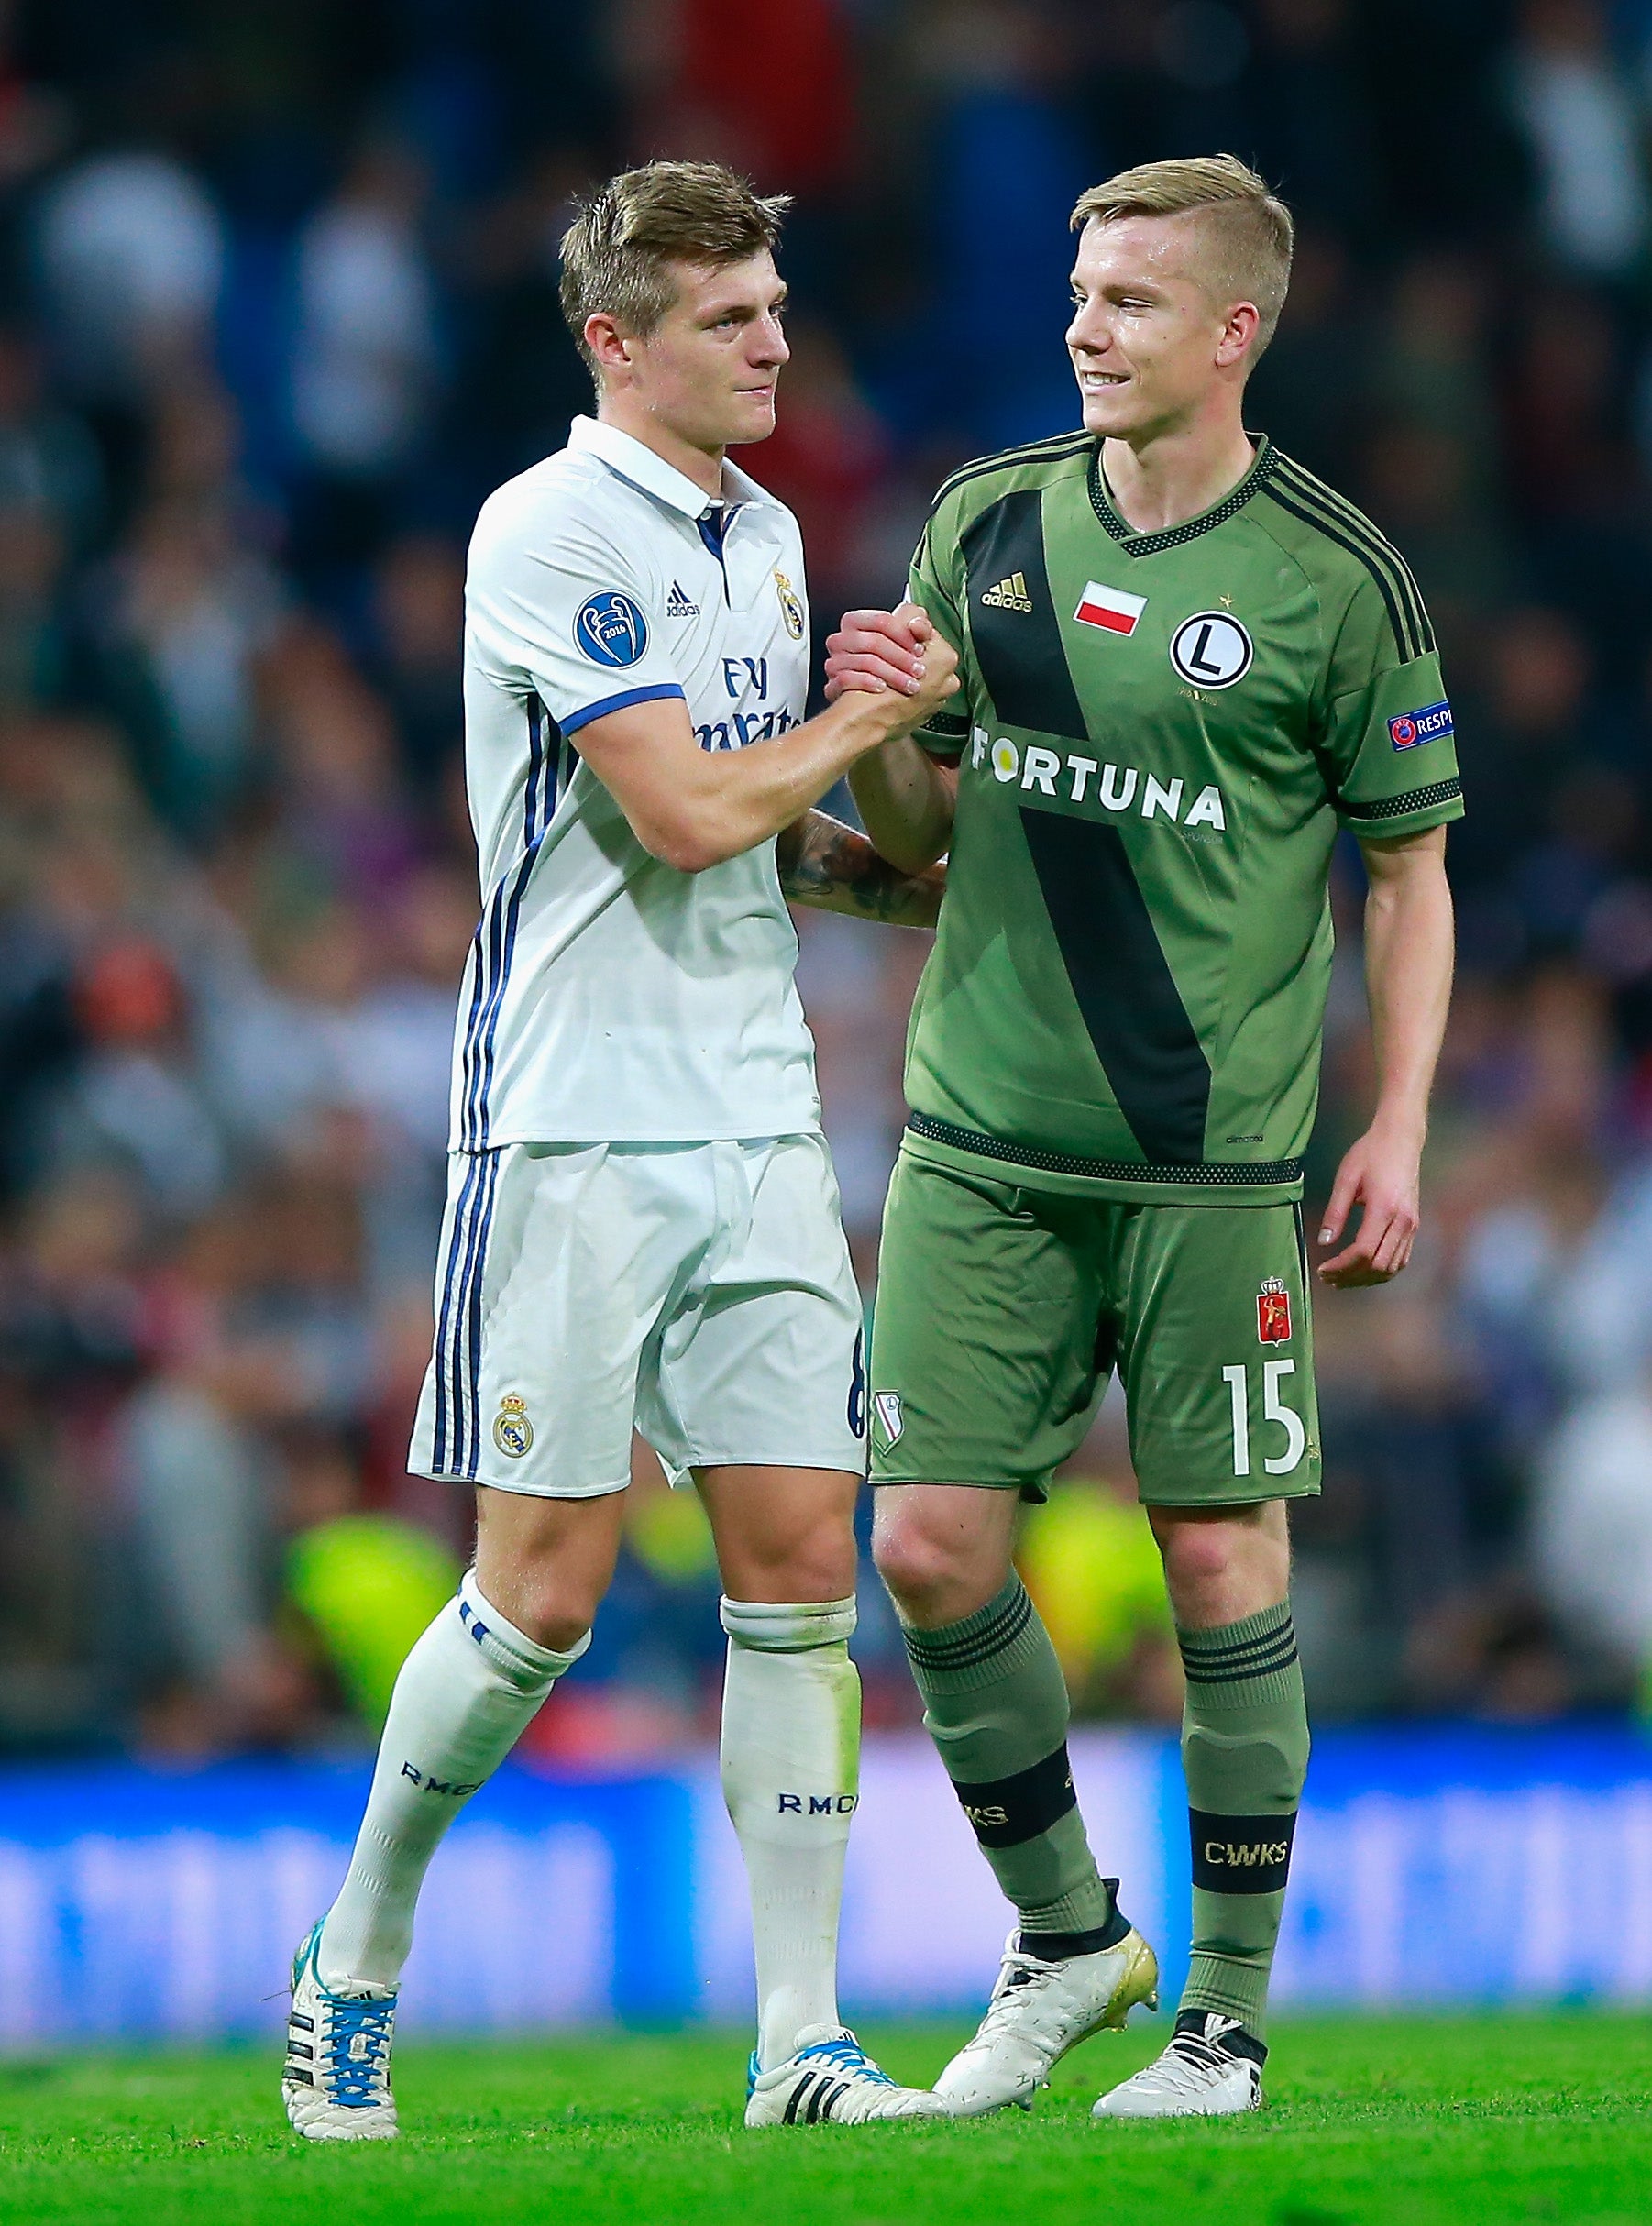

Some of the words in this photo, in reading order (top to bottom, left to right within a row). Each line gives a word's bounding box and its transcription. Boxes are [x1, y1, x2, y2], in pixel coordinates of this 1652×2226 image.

[981, 592, 1032, 612] adidas
[604, 624, 626, 639] 2016
[1189, 623, 1222, 676] L
[971, 726, 1227, 831] FORTUNA
[1222, 1359, 1305, 1476] 15
[401, 1760, 486, 1796] RMC
[964, 1804, 1008, 1827] KS
[1205, 1840, 1288, 1867] CWKS
